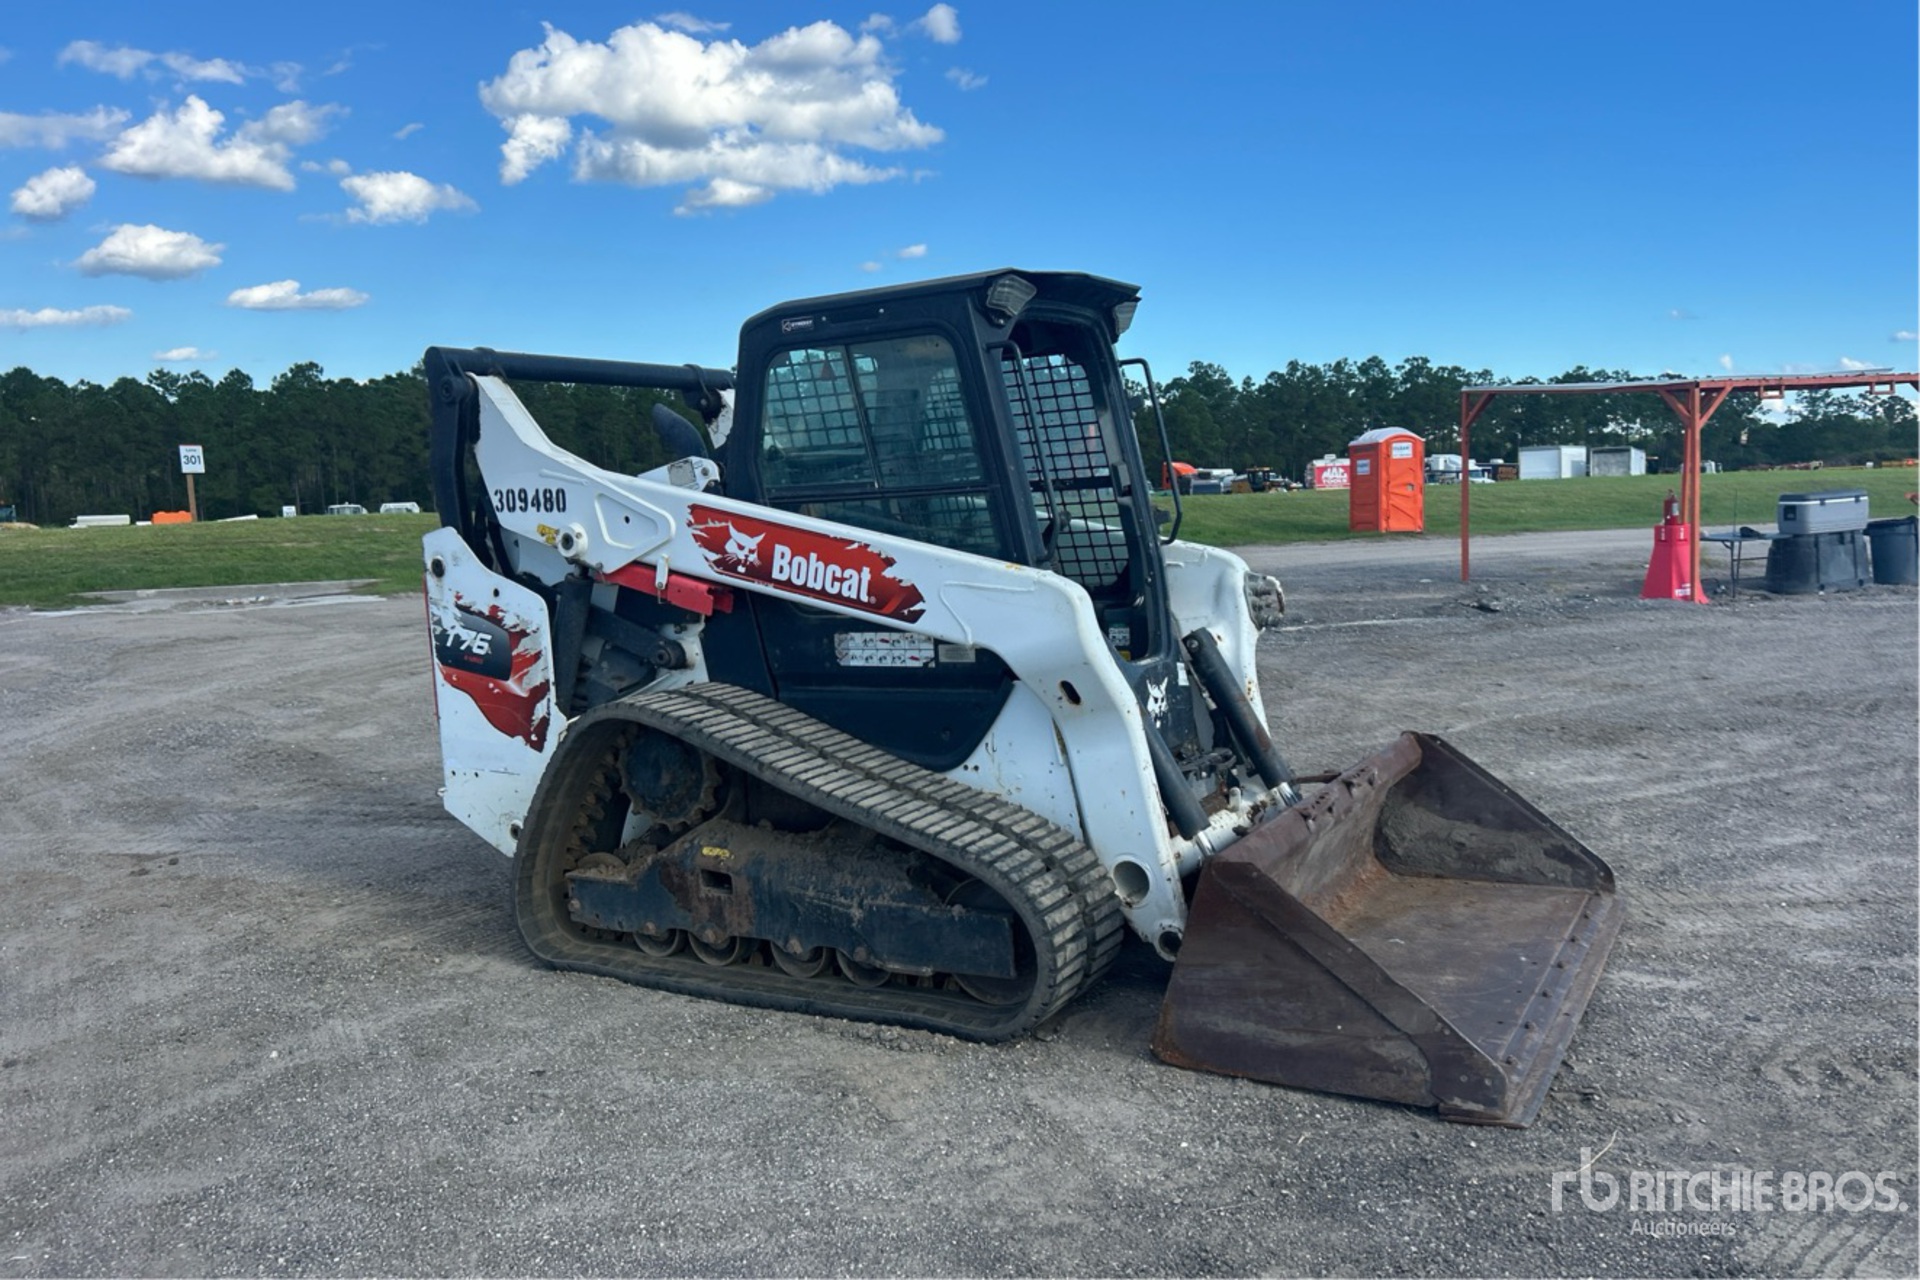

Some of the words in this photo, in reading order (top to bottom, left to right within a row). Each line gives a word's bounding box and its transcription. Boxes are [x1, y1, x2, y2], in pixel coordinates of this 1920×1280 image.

[183, 455, 201, 465] 301
[494, 488, 567, 513] 309480
[772, 543, 871, 603] Bobcat
